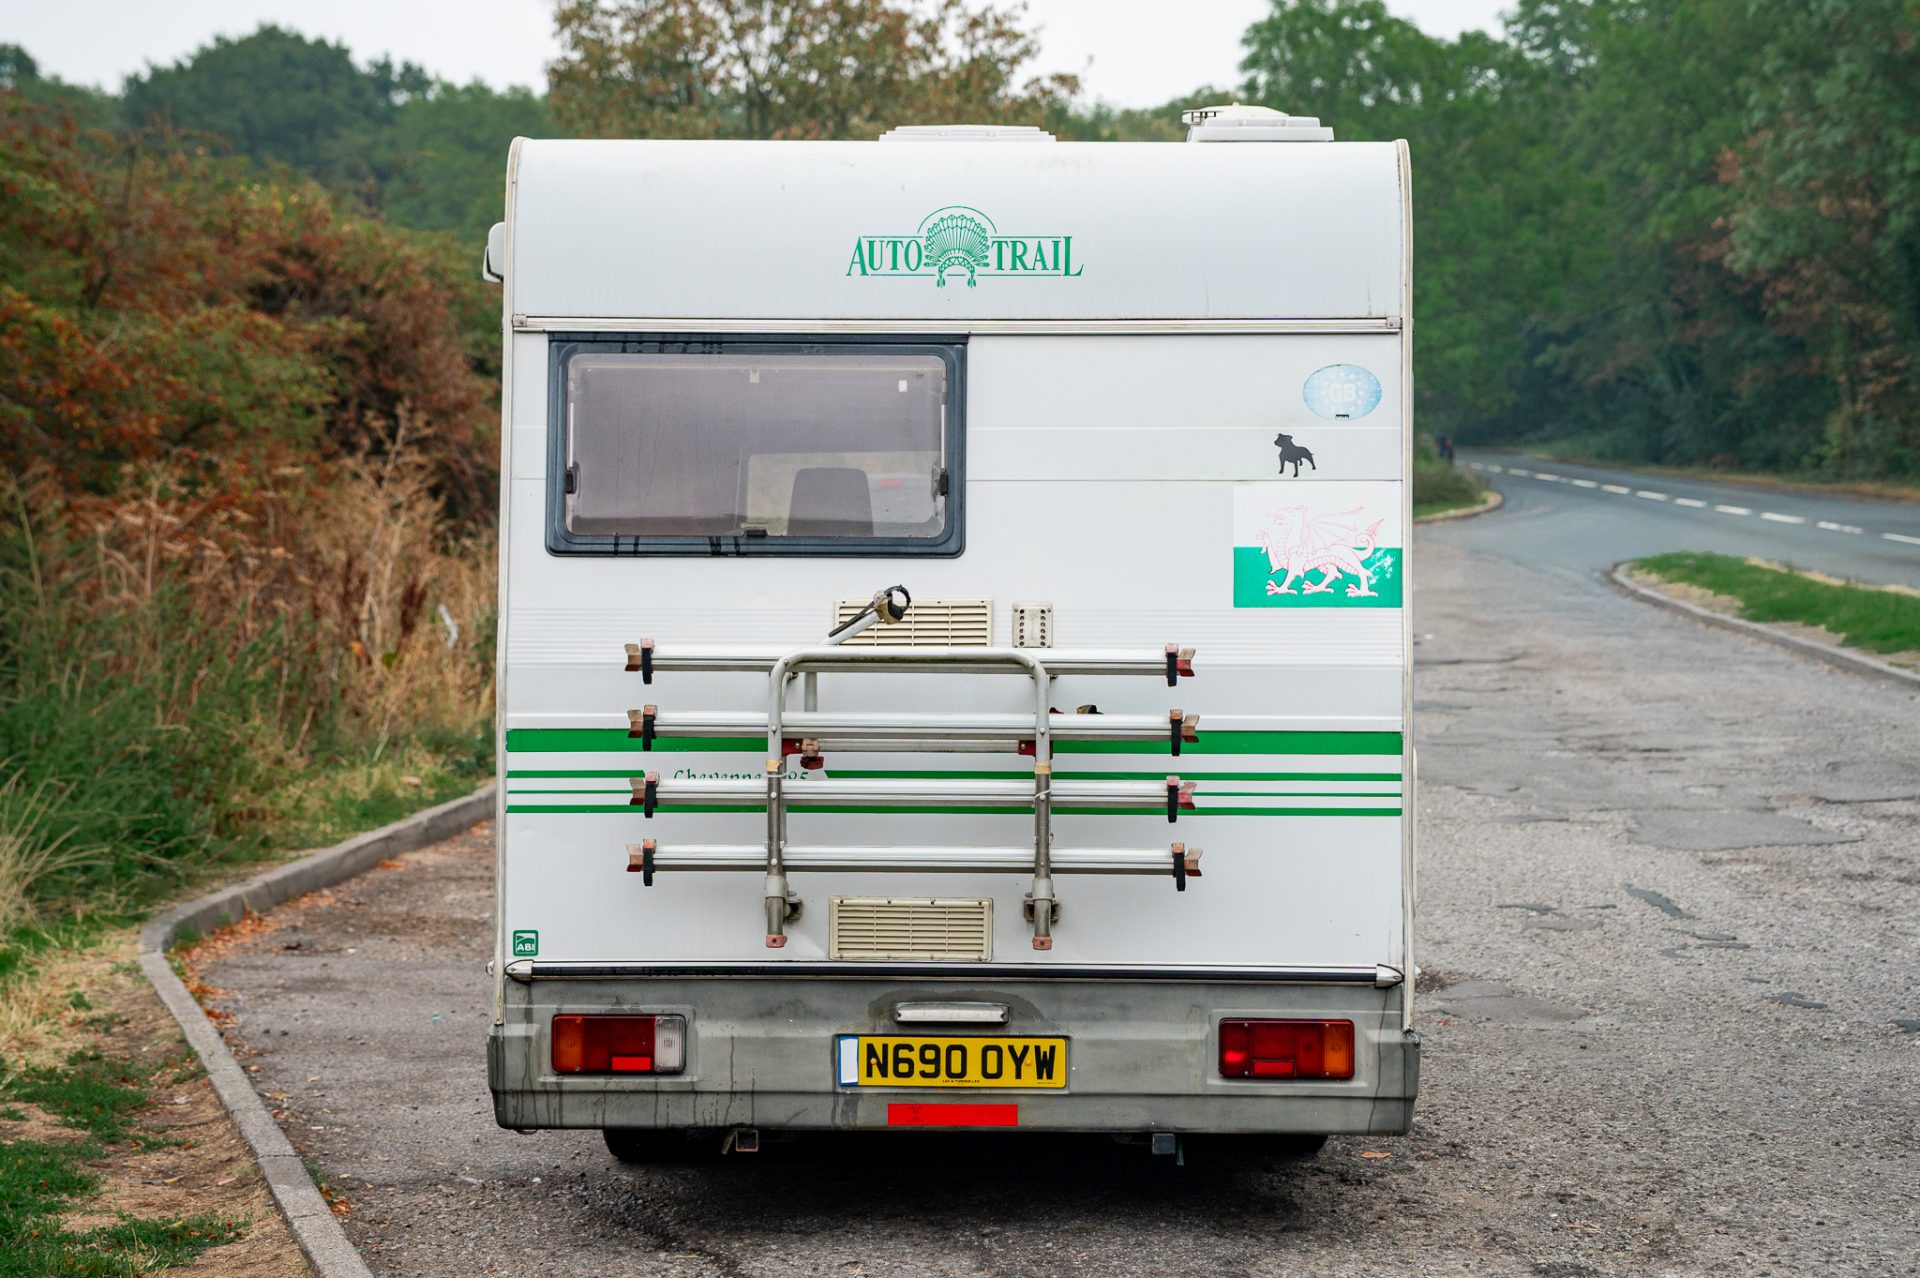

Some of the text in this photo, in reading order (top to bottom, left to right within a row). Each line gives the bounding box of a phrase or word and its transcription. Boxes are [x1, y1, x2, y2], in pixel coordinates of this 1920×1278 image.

[846, 236, 1084, 276] AUTO TRAIL
[1329, 384, 1357, 403] GB
[517, 943, 535, 951] ABI
[866, 1043, 1056, 1080] N690 OYW
